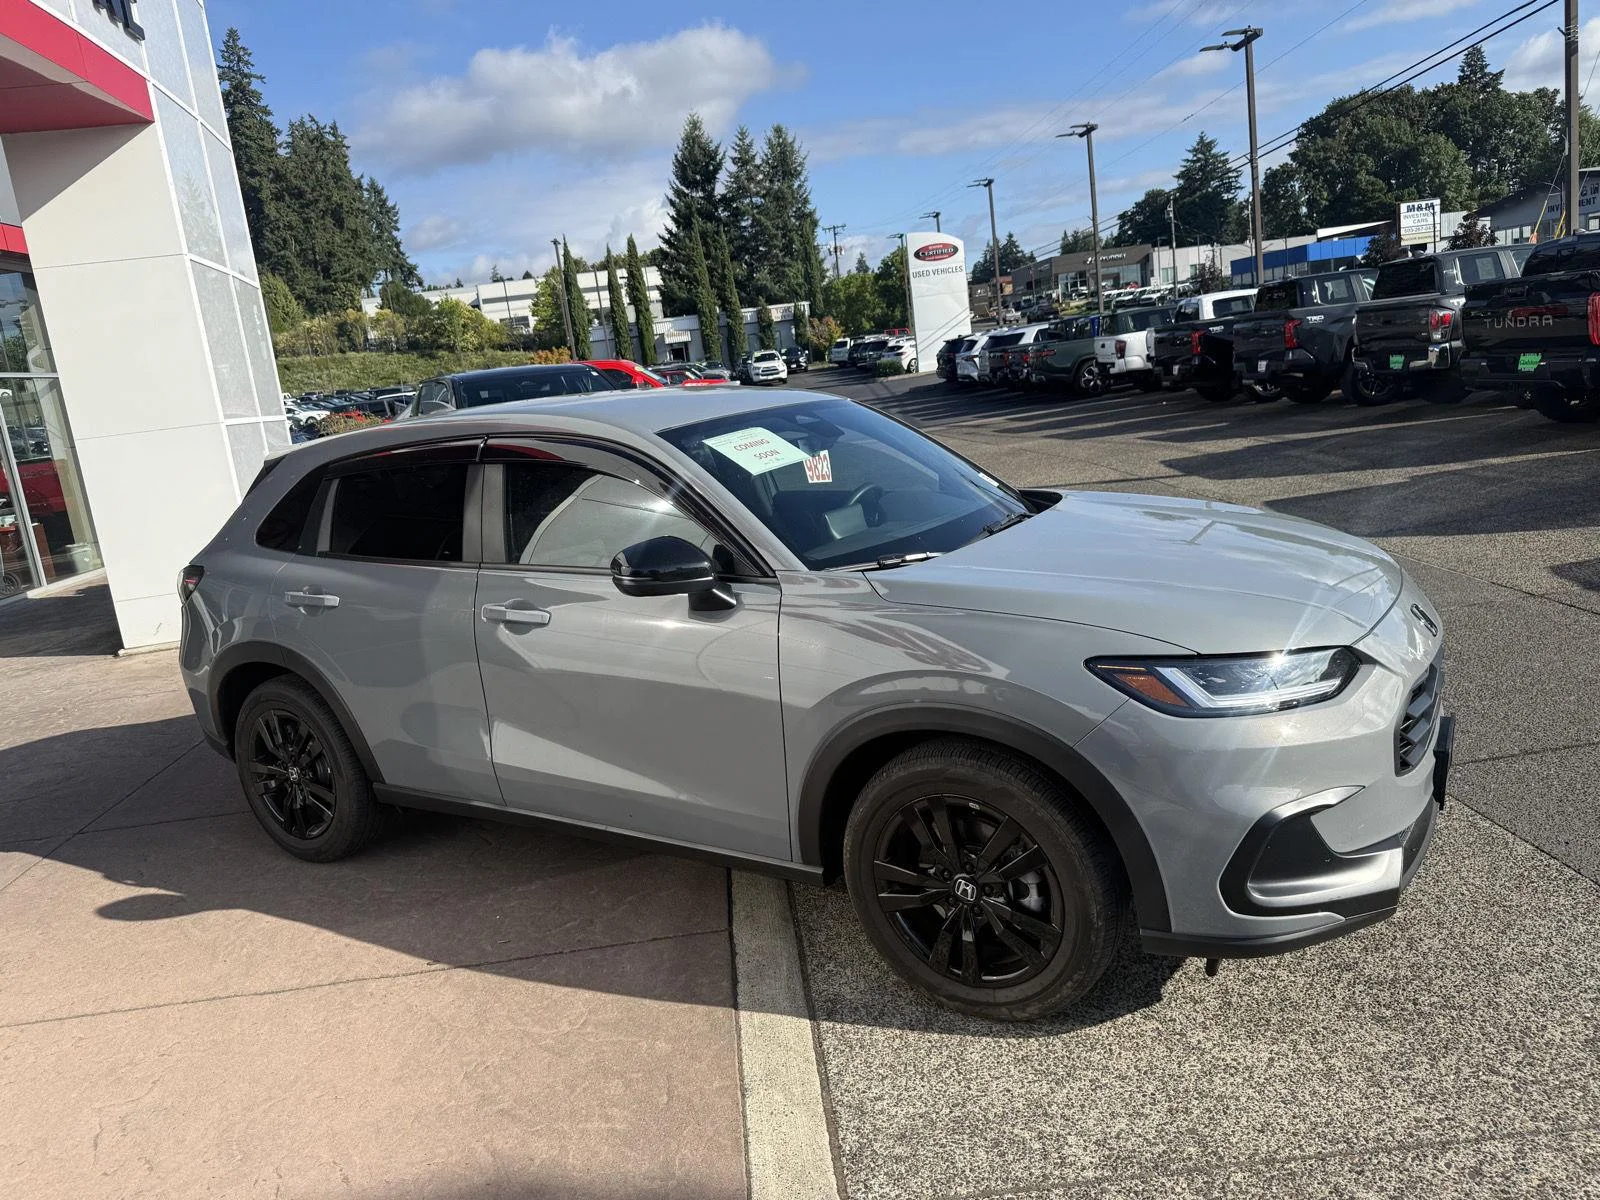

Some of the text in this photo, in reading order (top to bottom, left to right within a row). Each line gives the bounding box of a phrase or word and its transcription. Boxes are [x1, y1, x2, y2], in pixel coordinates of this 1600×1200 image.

[1406, 202, 1434, 213] M&M
[919, 247, 955, 257] CERTIFIED
[912, 265, 964, 279] USED VEHICLES
[1484, 315, 1553, 329] TUNDRA
[733, 438, 771, 452] COMING
[754, 449, 781, 461] SOON
[804, 453, 831, 481] 9823
